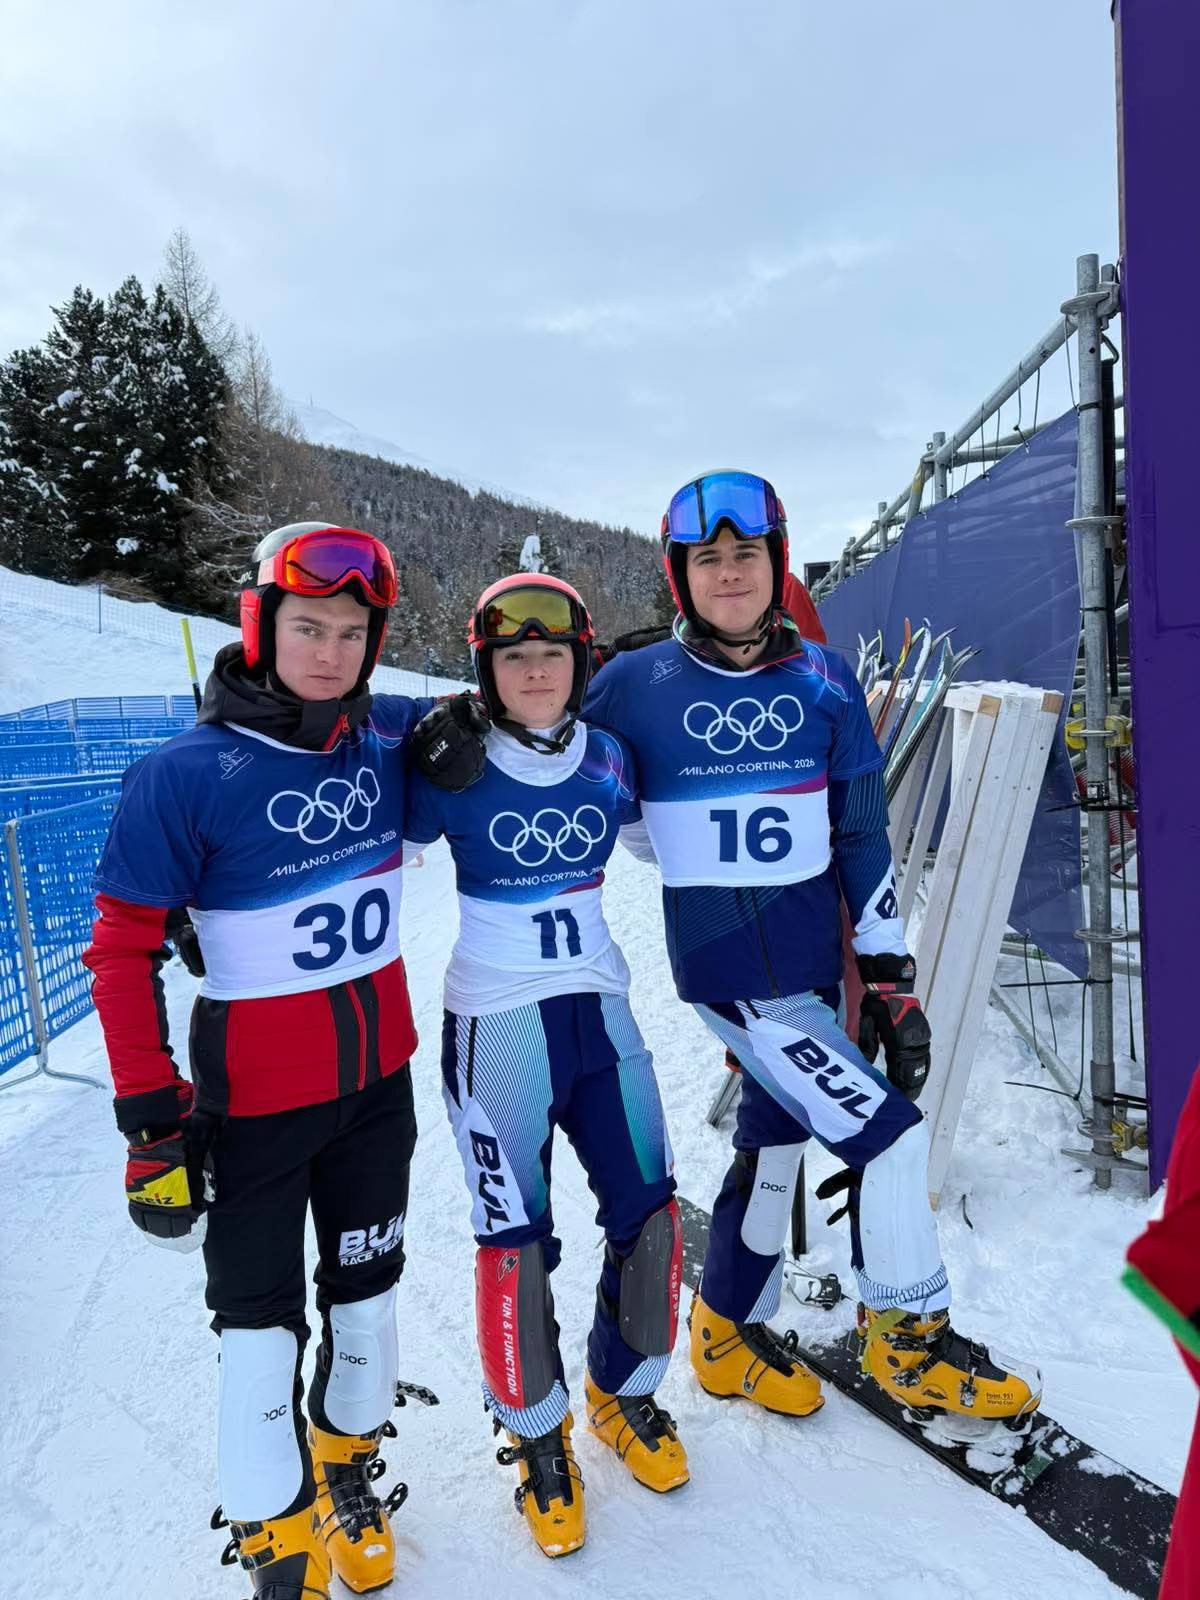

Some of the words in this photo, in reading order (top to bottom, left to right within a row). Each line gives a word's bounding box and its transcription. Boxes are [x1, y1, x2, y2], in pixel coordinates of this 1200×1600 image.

[677, 763, 734, 777] MILANO
[736, 760, 792, 773] CORTINA
[794, 758, 815, 769] 2026
[709, 806, 793, 864] 16
[267, 855, 330, 880] MILANO
[332, 838, 380, 862] CORTINA
[380, 828, 397, 844] 2026
[489, 876, 540, 887] MILANO
[541, 870, 588, 883] CORTINA
[292, 888, 390, 971] 30
[531, 908, 582, 959] 11
[340, 1250, 374, 1267] RACE
[502, 1295, 513, 1318] FUN
[503, 1320, 513, 1330] &
[504, 1332, 519, 1397] FUNCTION
